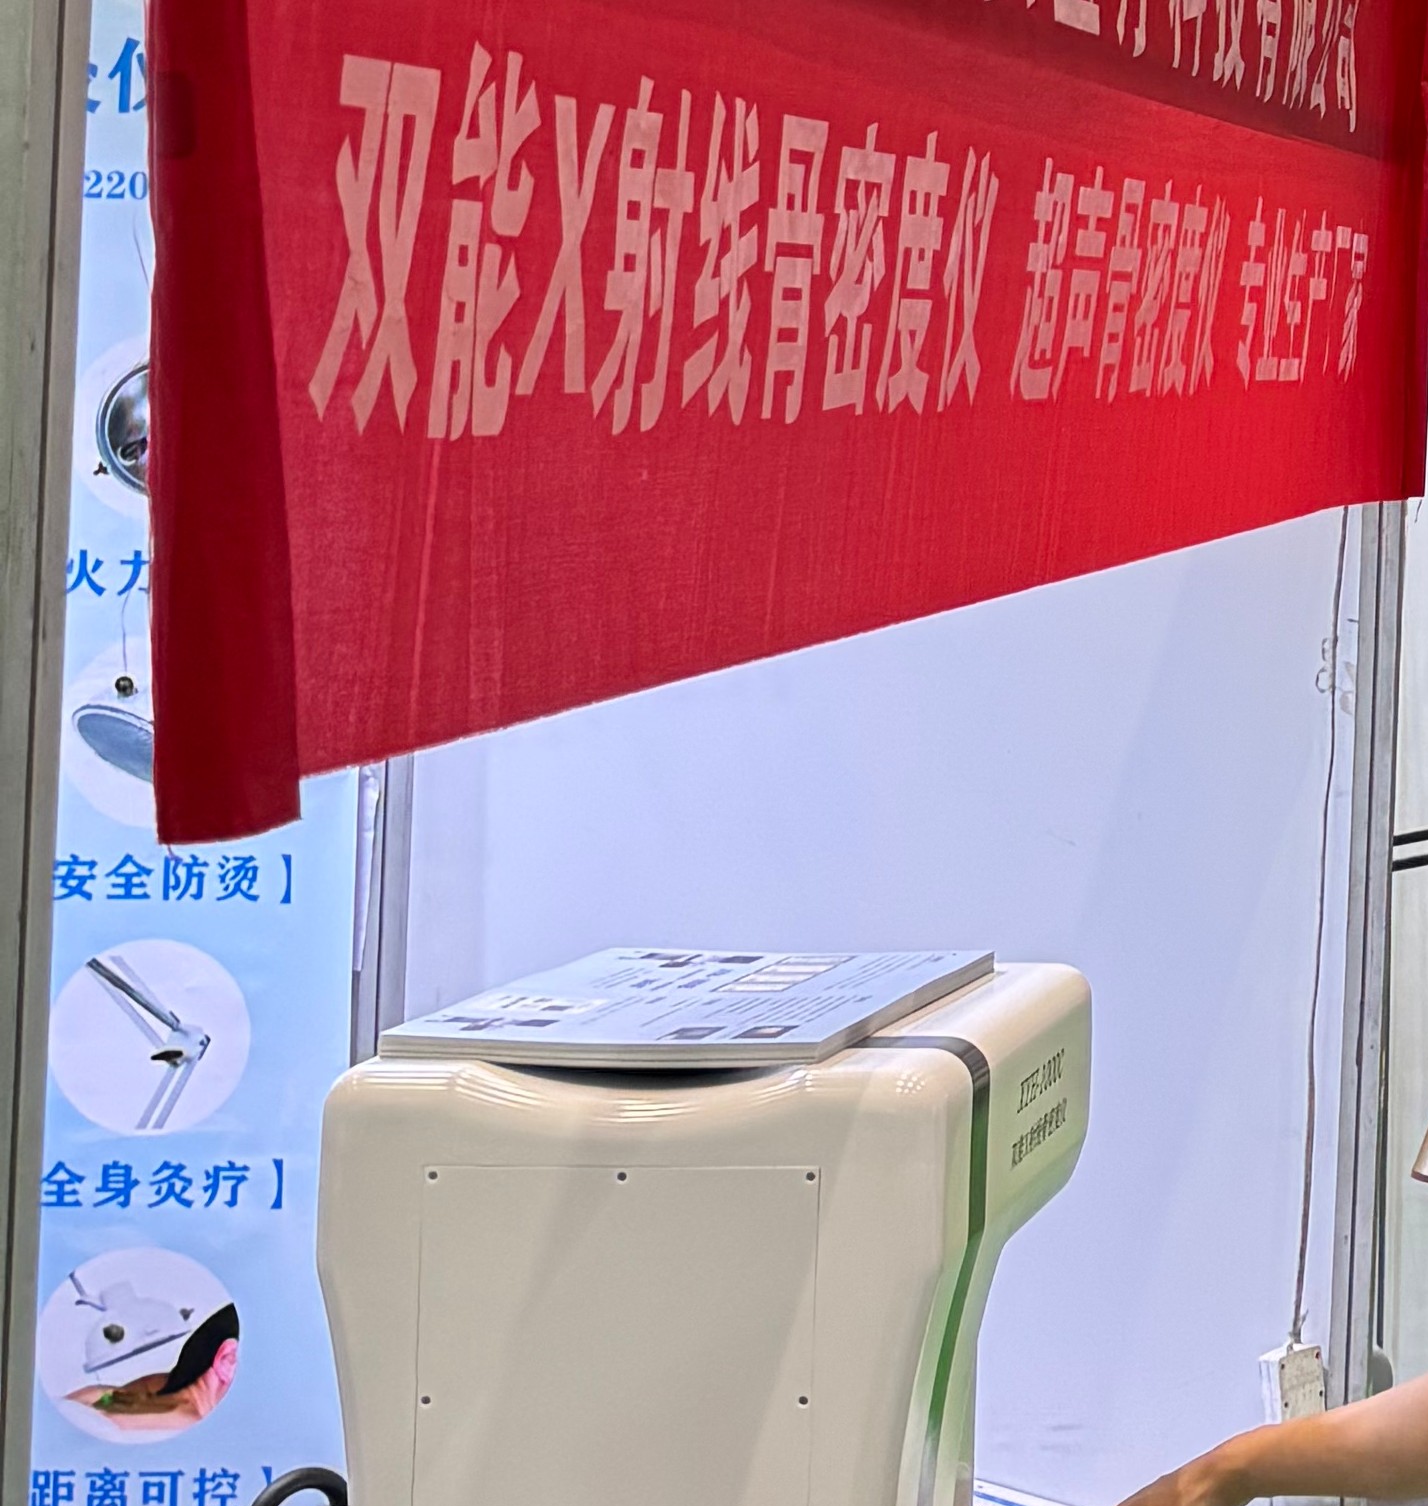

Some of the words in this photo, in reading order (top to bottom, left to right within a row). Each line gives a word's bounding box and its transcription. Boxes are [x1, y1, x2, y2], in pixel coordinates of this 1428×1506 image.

[308, 40, 999, 440] 双能X射线骨密度仪
[1010, 156, 1231, 402] 超声骨密度仪
[1236, 195, 1369, 390] 专业生产厂家
